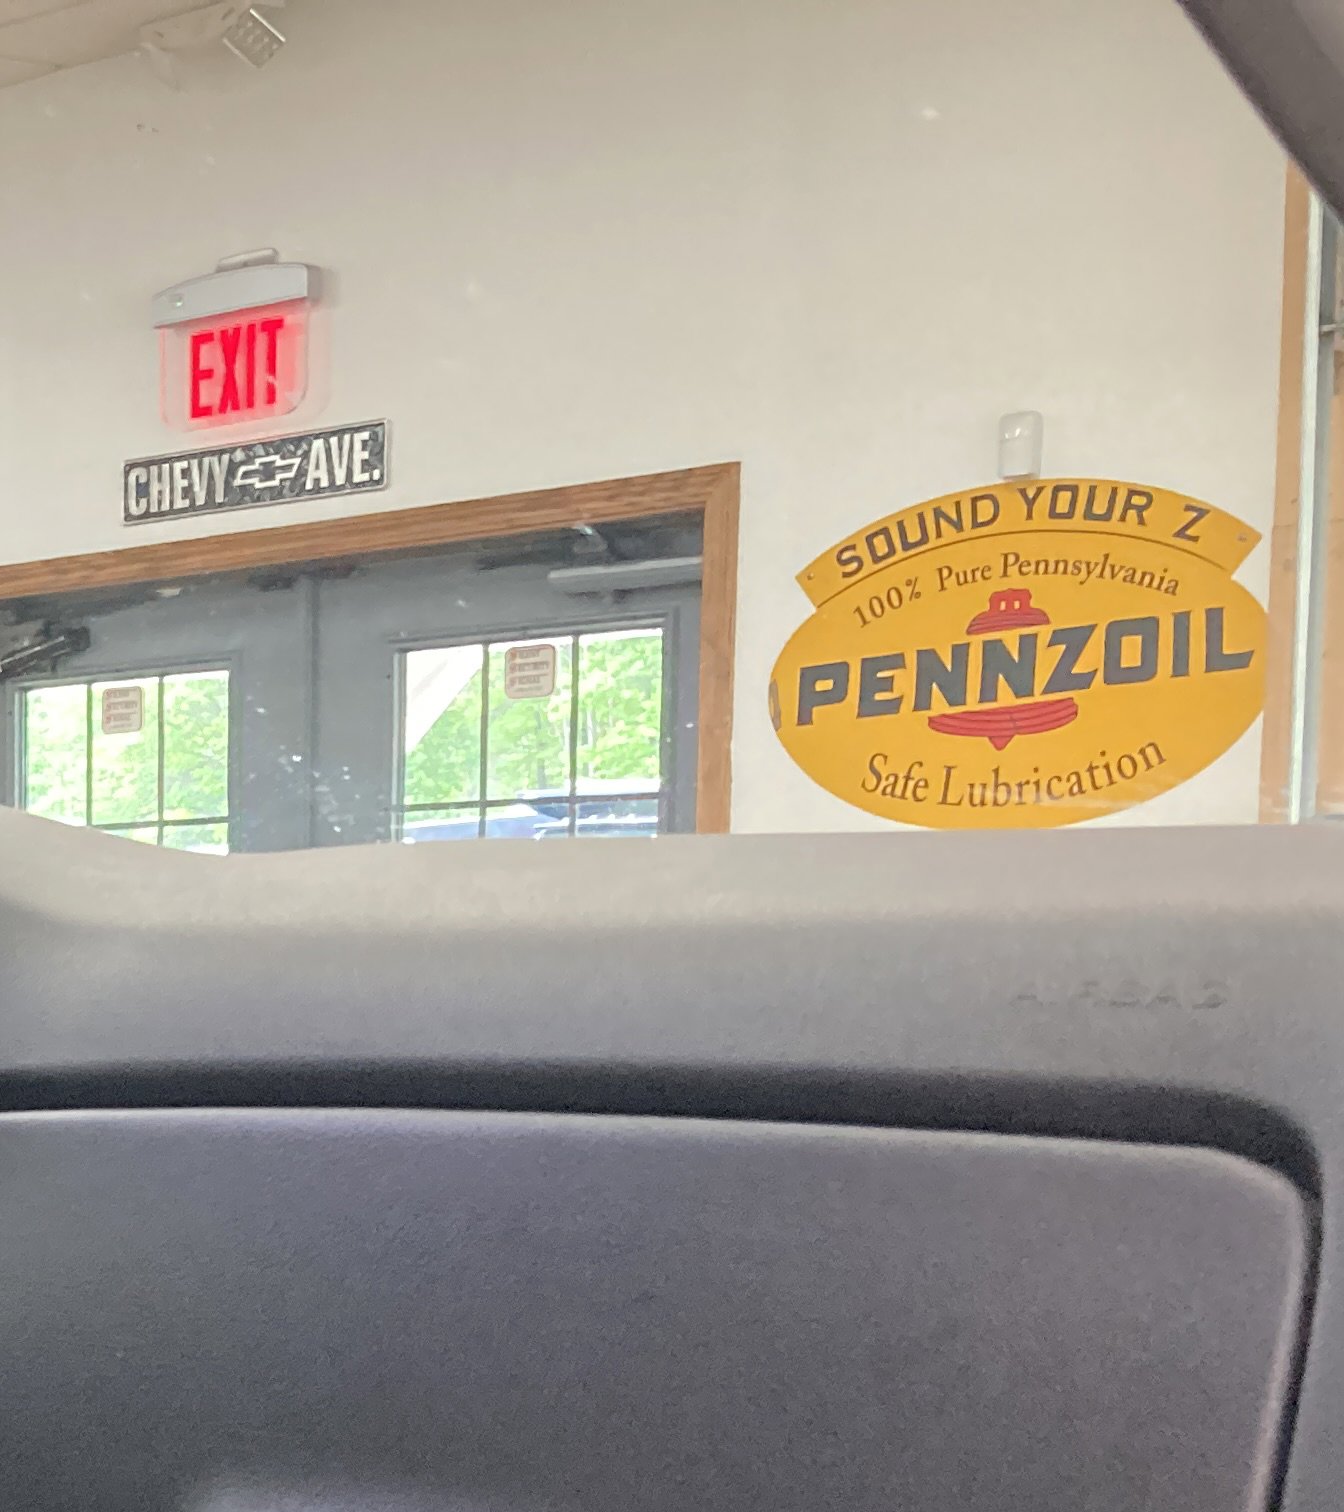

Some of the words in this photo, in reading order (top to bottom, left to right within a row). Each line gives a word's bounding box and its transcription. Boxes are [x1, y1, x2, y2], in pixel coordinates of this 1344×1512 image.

[188, 319, 284, 419] EXIT
[127, 454, 229, 515] CHEVY
[305, 431, 381, 491] AVE.
[835, 493, 1001, 580] SOUND
[1017, 484, 1154, 526] YOUR
[1171, 503, 1212, 544] Z
[853, 576, 923, 628] 100%
[937, 560, 994, 593] Pure
[999, 551, 1180, 598] Pennsylvania
[796, 606, 1255, 727] PENNZOIL
[861, 751, 930, 801] Safe
[938, 740, 1167, 809] Lubrication
